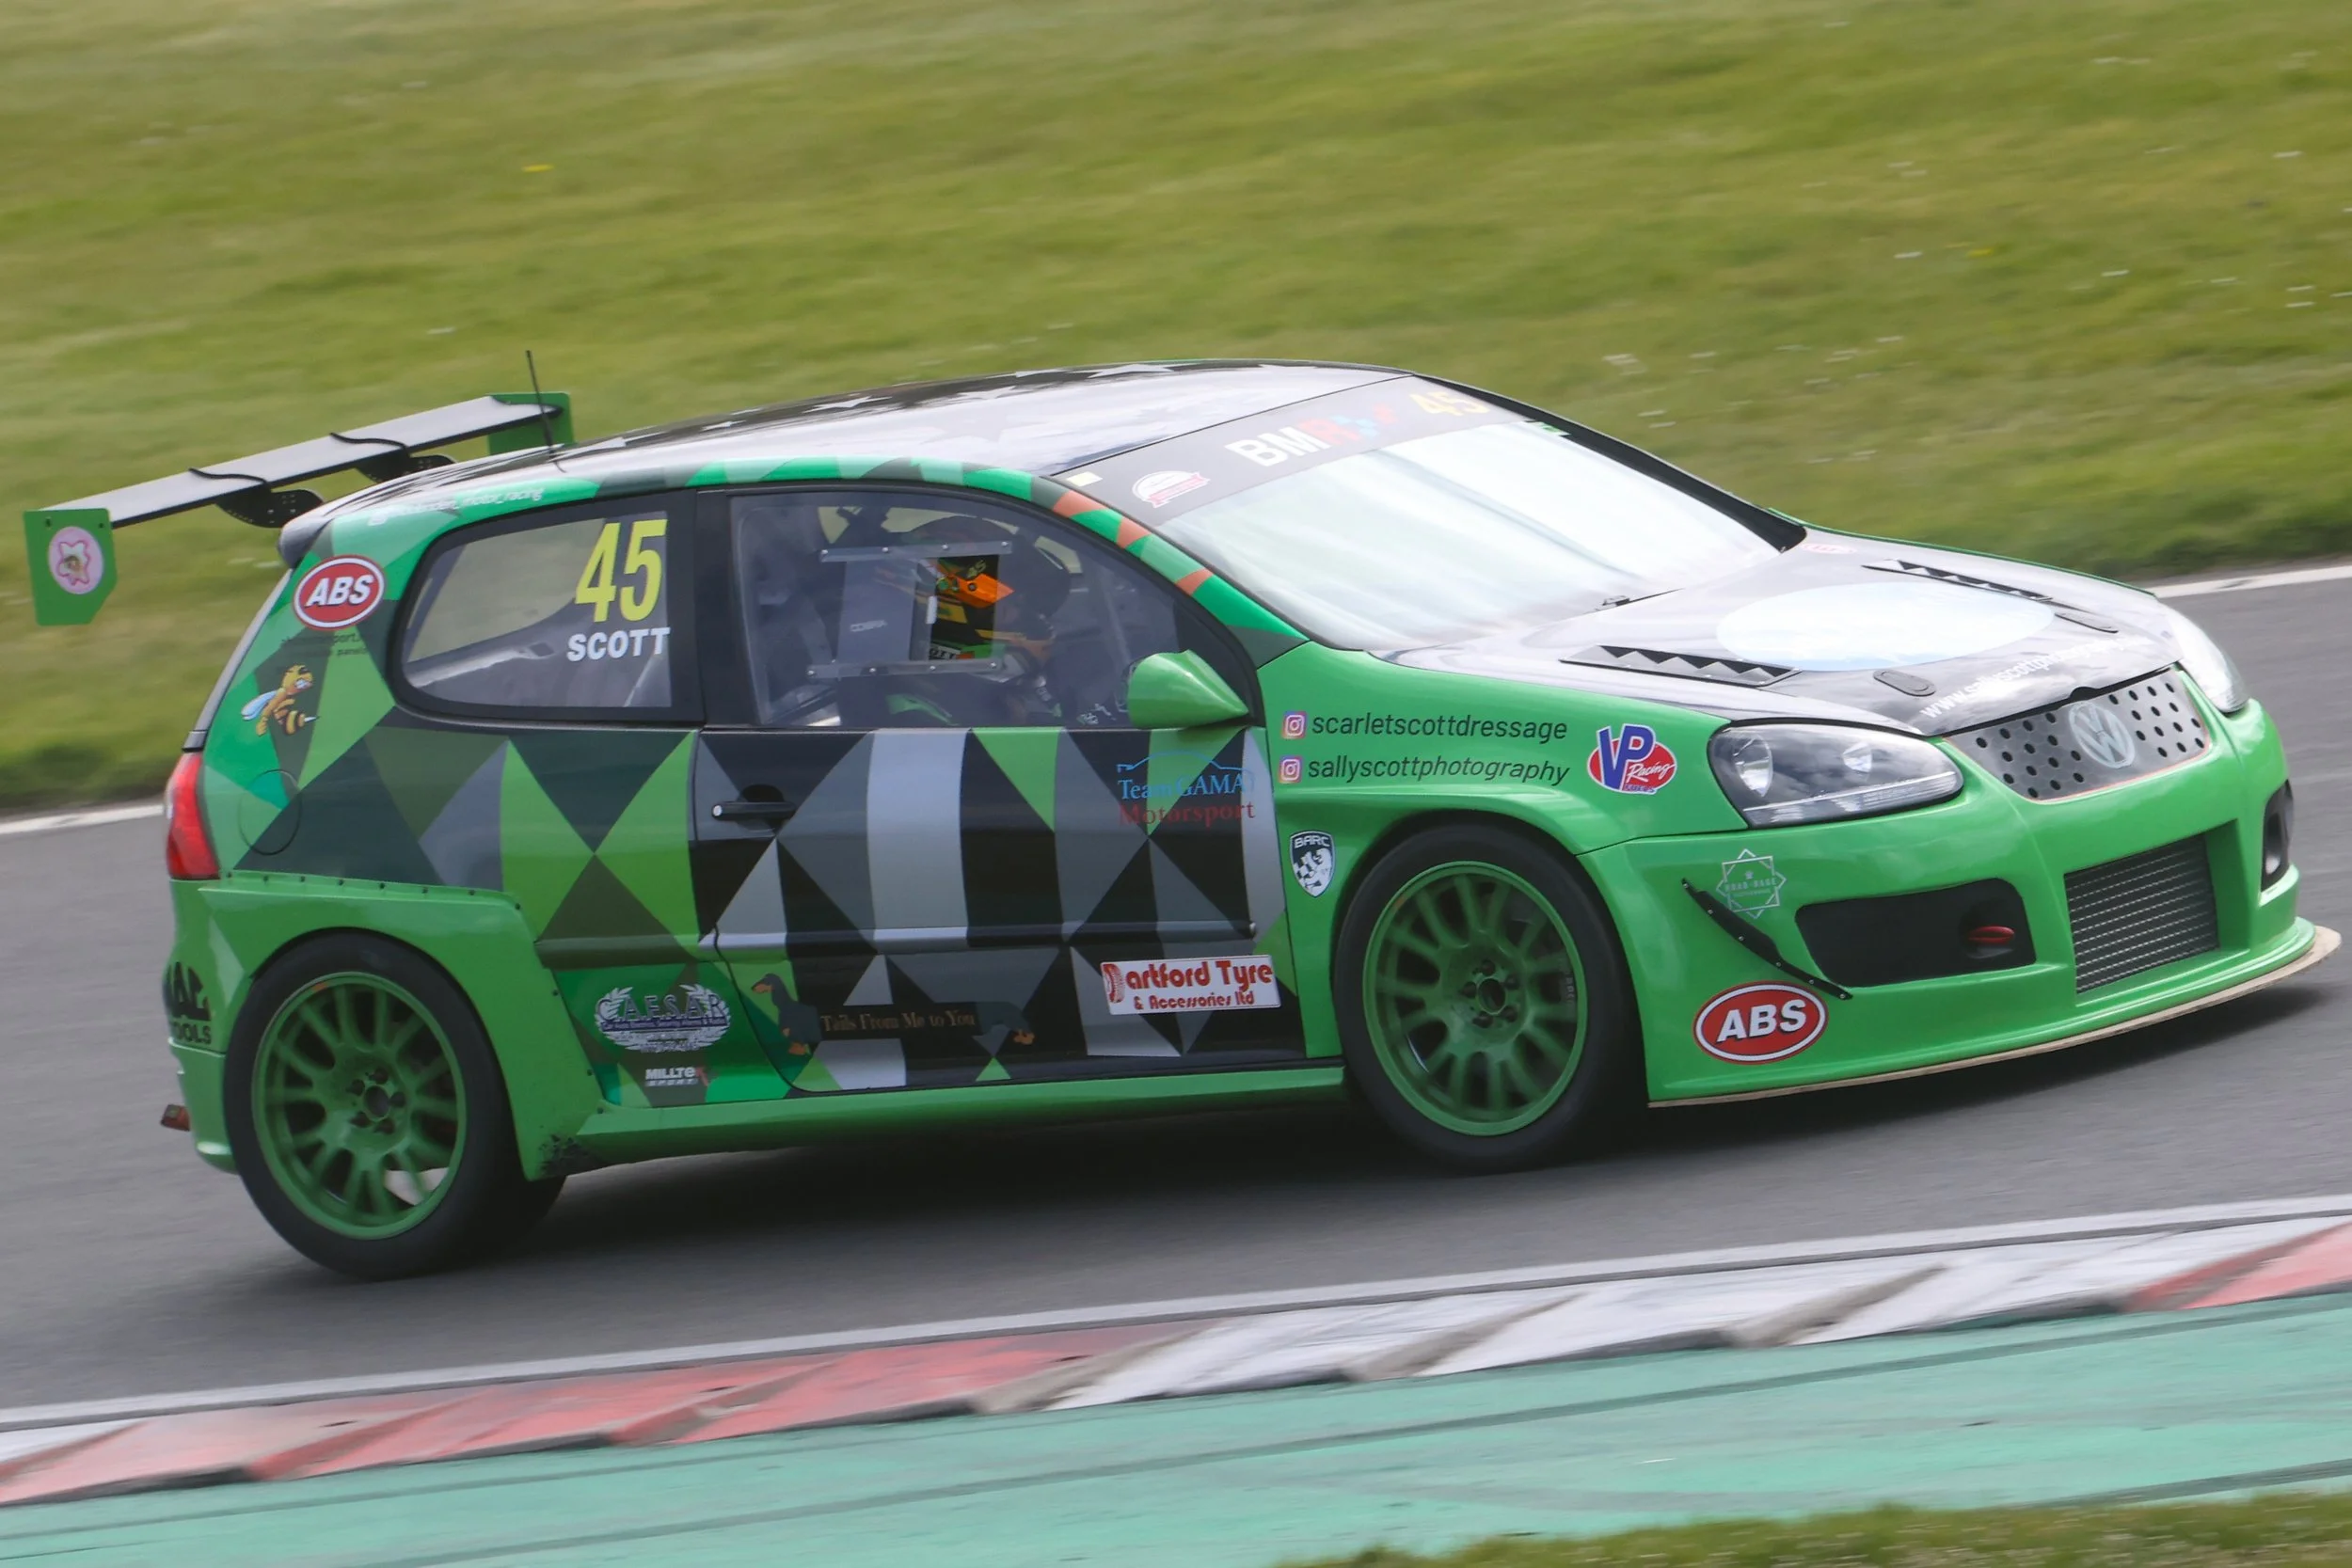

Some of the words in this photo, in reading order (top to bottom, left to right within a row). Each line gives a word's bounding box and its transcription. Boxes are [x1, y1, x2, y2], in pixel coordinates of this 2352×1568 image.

[1409, 391, 1490, 416] 45
[575, 519, 668, 622] 45
[305, 575, 374, 608] ABS
[566, 626, 671, 662] SCOTT
[1311, 712, 1567, 744] scarletscottdressage
[1308, 754, 1570, 785] sallyscottphotography
[1597, 723, 1656, 792] VP
[1626, 761, 1676, 783] Racing
[1117, 779, 1171, 800] Team
[1176, 773, 1247, 797] GAMA
[1120, 801, 1256, 828] Motorsport
[1295, 834, 1330, 848] BARC
[1103, 961, 1211, 1004] Dartford
[1216, 959, 1273, 992] Tyre
[1134, 995, 1144, 1010] &
[1149, 992, 1232, 1010] Accessories
[859, 1013, 899, 1030] From
[901, 1011, 926, 1029] Me
[929, 1014, 945, 1027] to
[945, 1009, 976, 1027] You
[1715, 999, 1806, 1044] ABS
